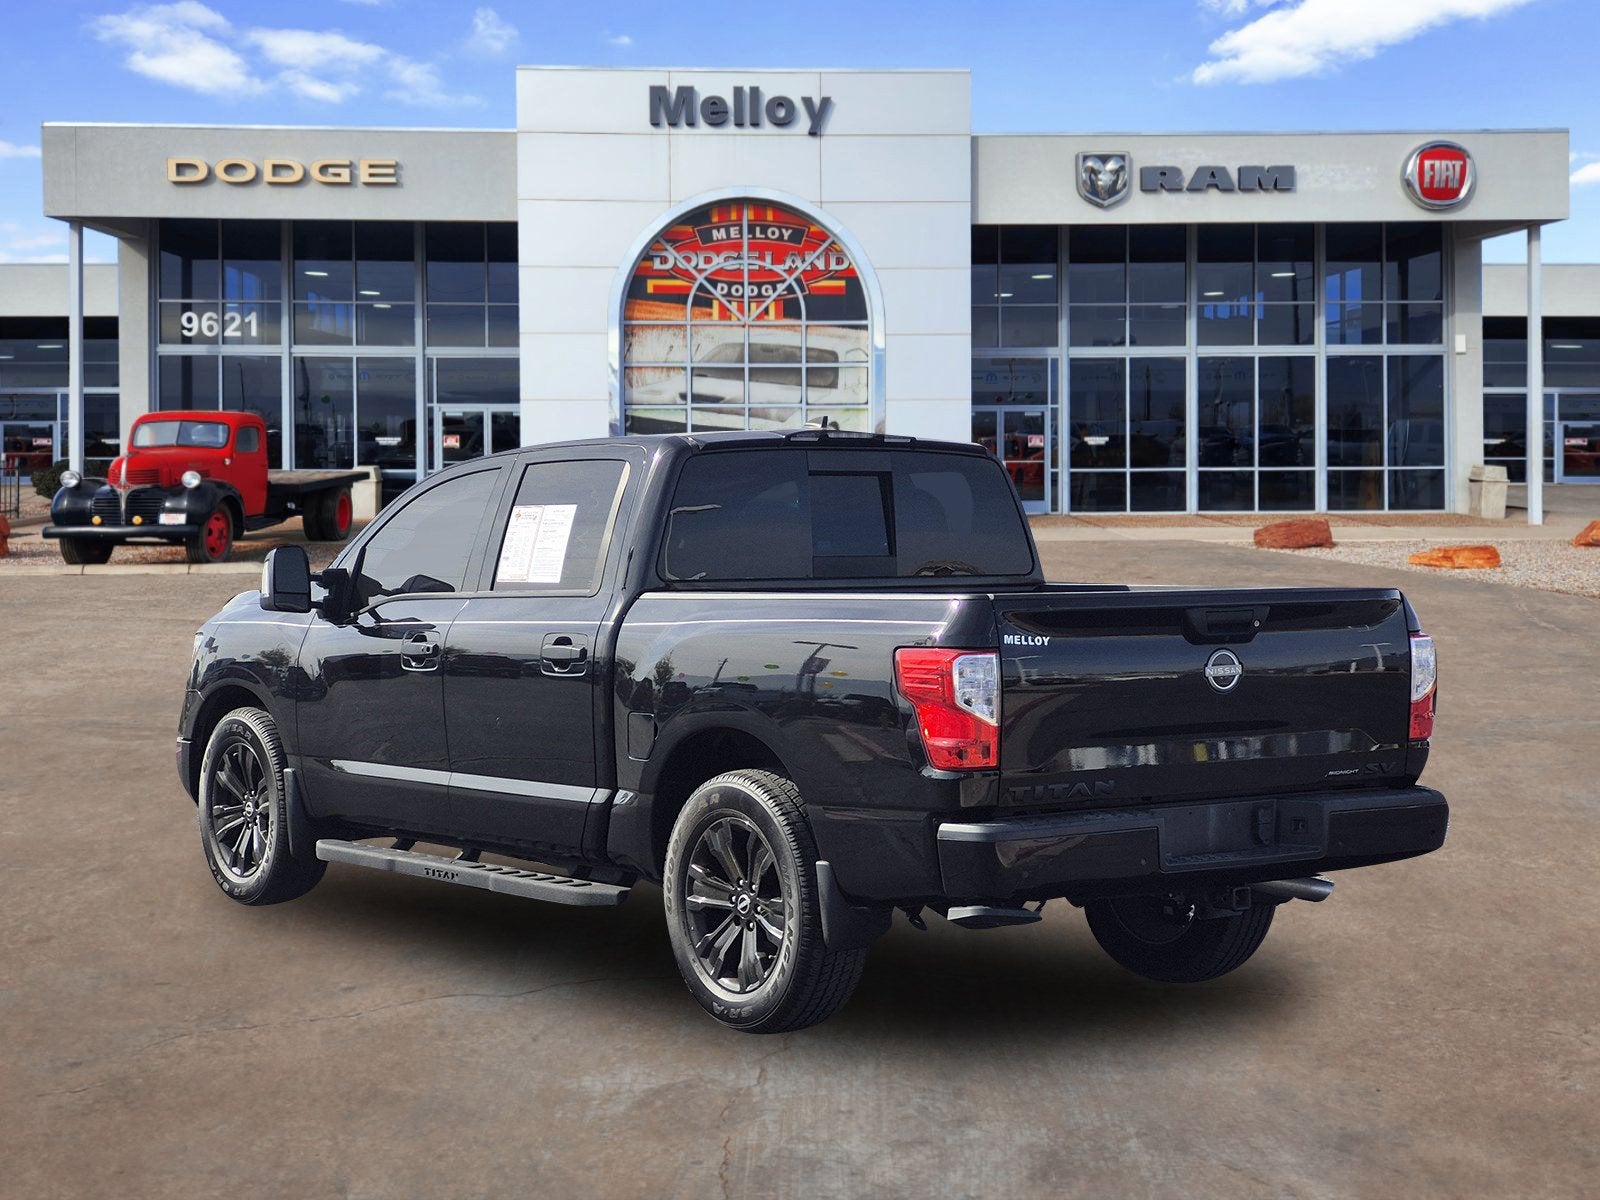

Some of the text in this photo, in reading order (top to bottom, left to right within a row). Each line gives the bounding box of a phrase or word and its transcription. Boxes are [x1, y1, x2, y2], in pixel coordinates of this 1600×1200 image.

[649, 85, 833, 136] Melloy
[167, 158, 399, 184] DODGE
[1139, 165, 1297, 193] RAM
[1423, 159, 1464, 189] FIAT
[711, 226, 793, 241] MELOY
[181, 311, 257, 337] 9621
[1003, 634, 1050, 646] MELLOY
[1206, 667, 1241, 676] NISSAN
[1328, 761, 1397, 776] MIDNIGHT SV
[1009, 780, 1116, 801] TITAN
